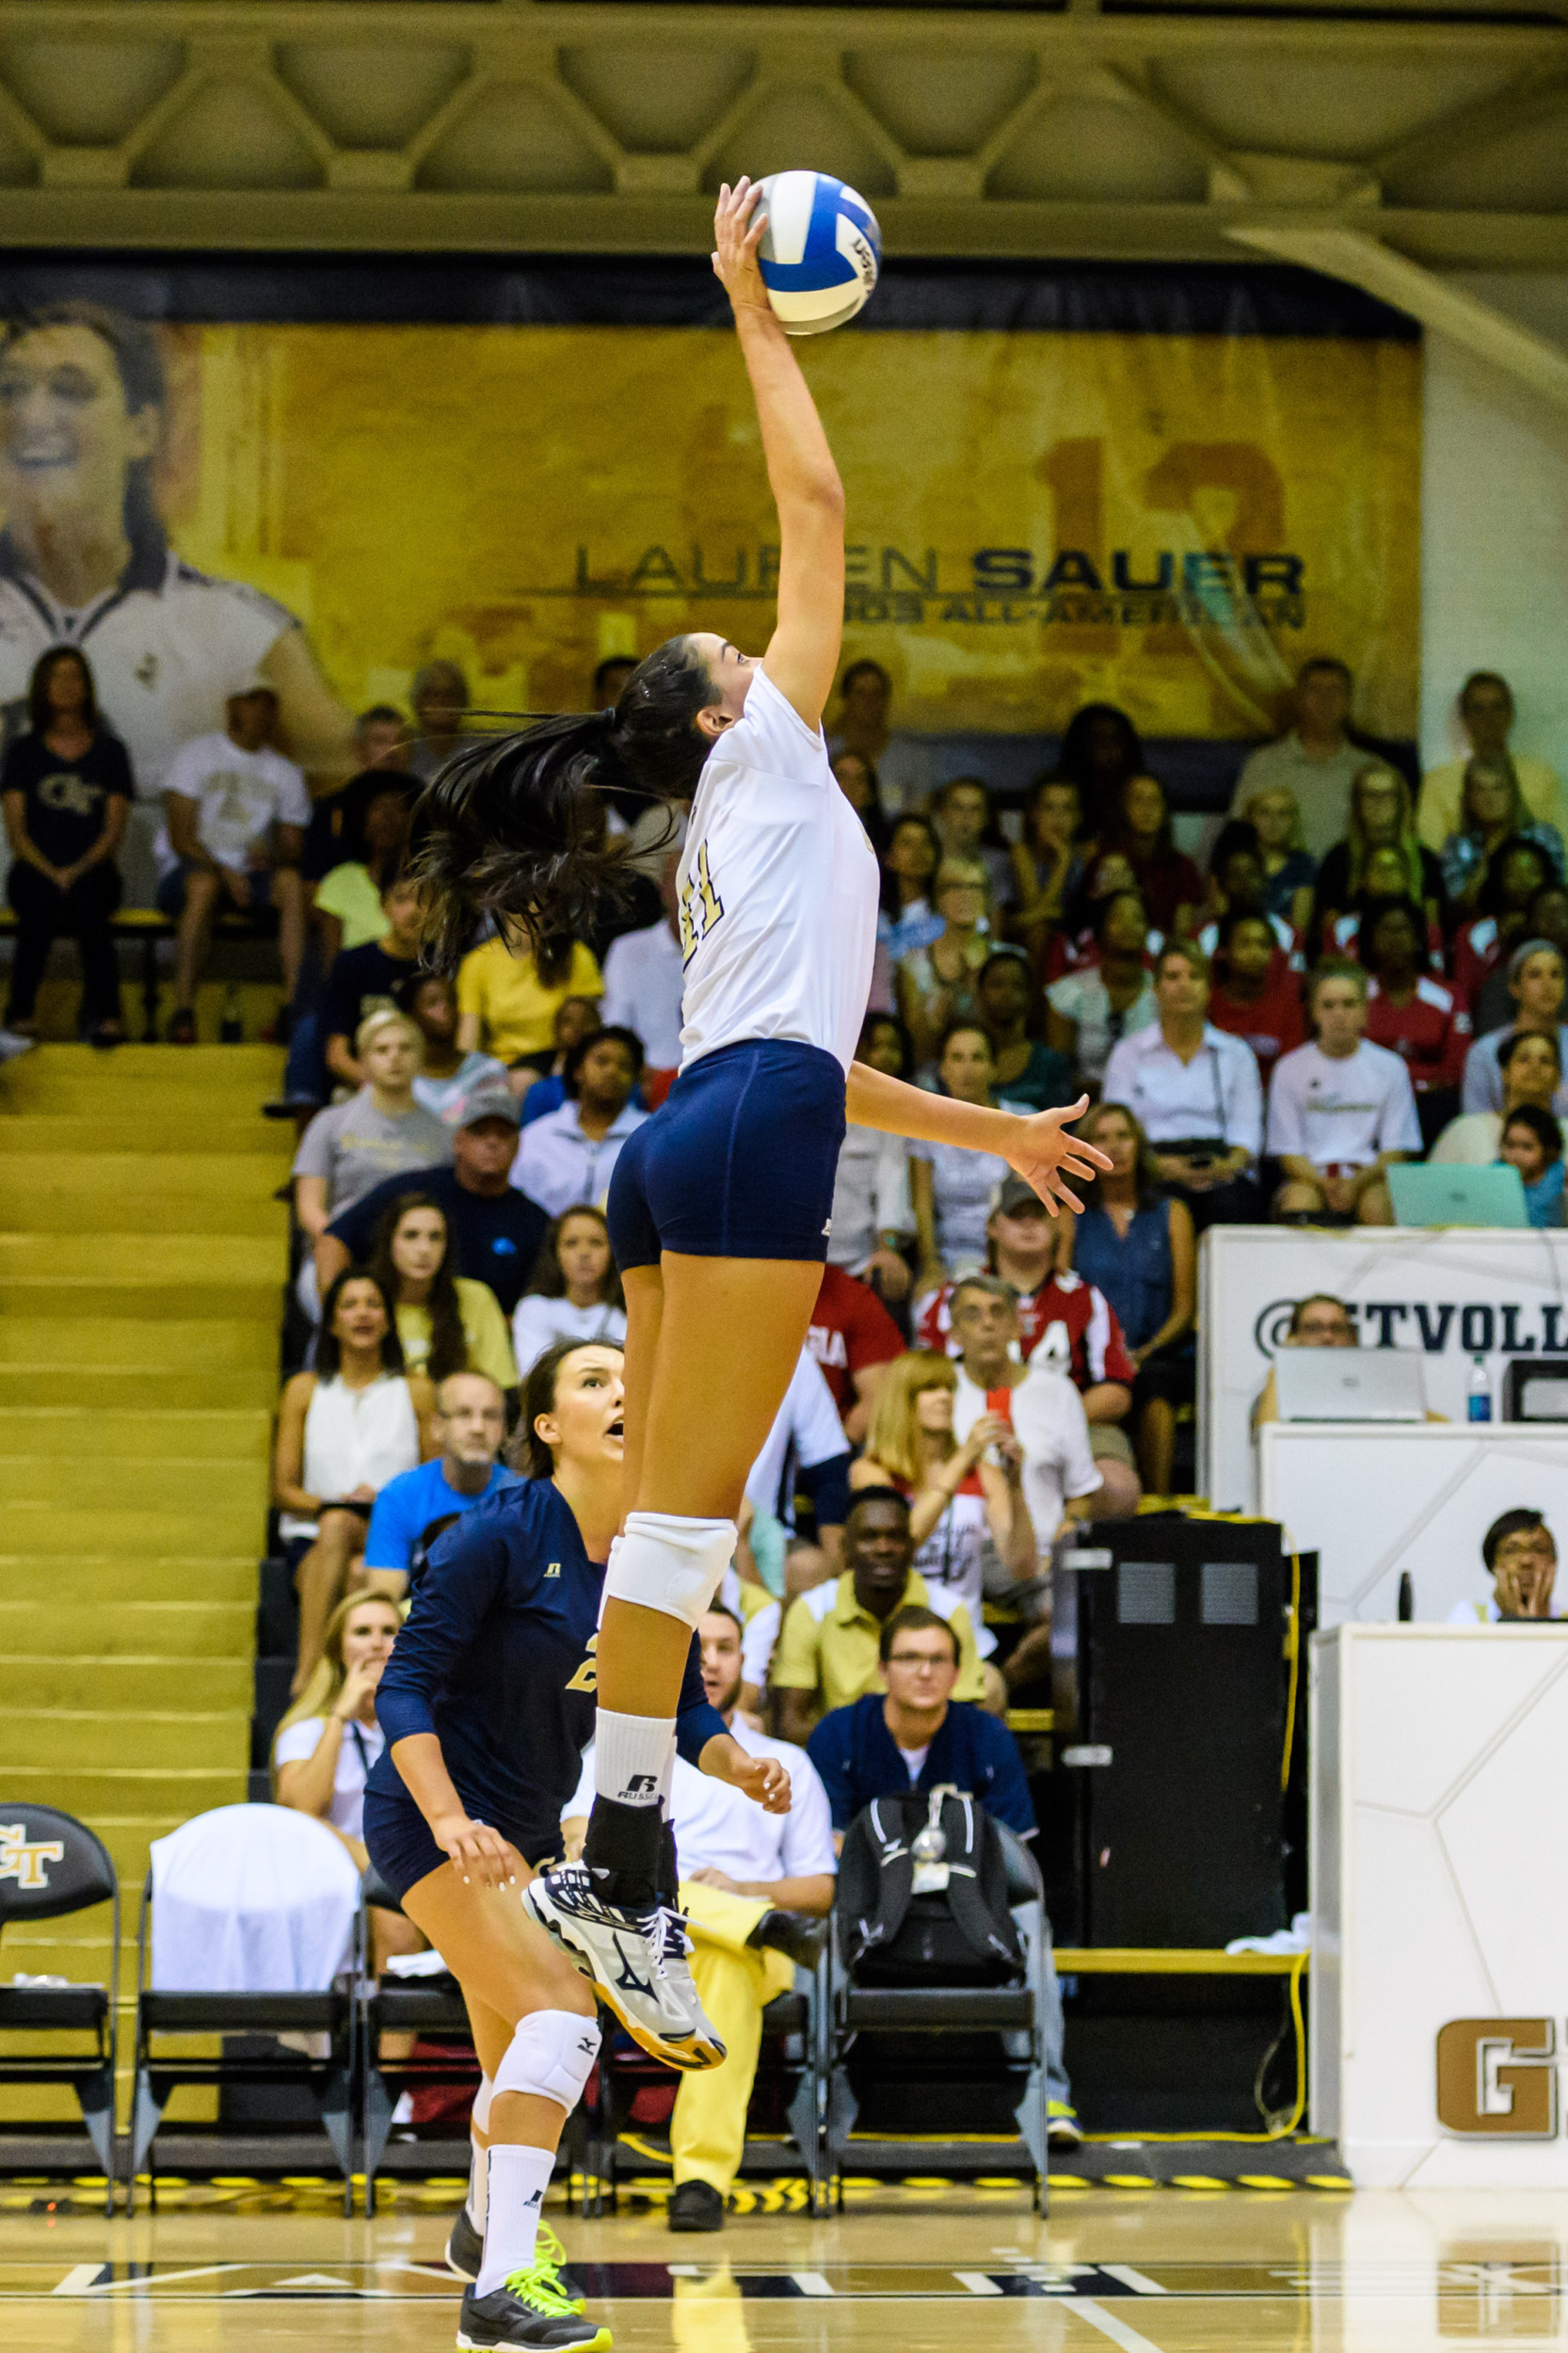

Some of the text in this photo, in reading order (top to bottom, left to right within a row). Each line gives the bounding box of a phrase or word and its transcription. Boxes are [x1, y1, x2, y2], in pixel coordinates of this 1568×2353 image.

[973, 548, 1305, 595] SAUER
[941, 599, 1306, 631] ALL-AMERIAN
[1255, 1298, 1568, 1361] TVOLL
